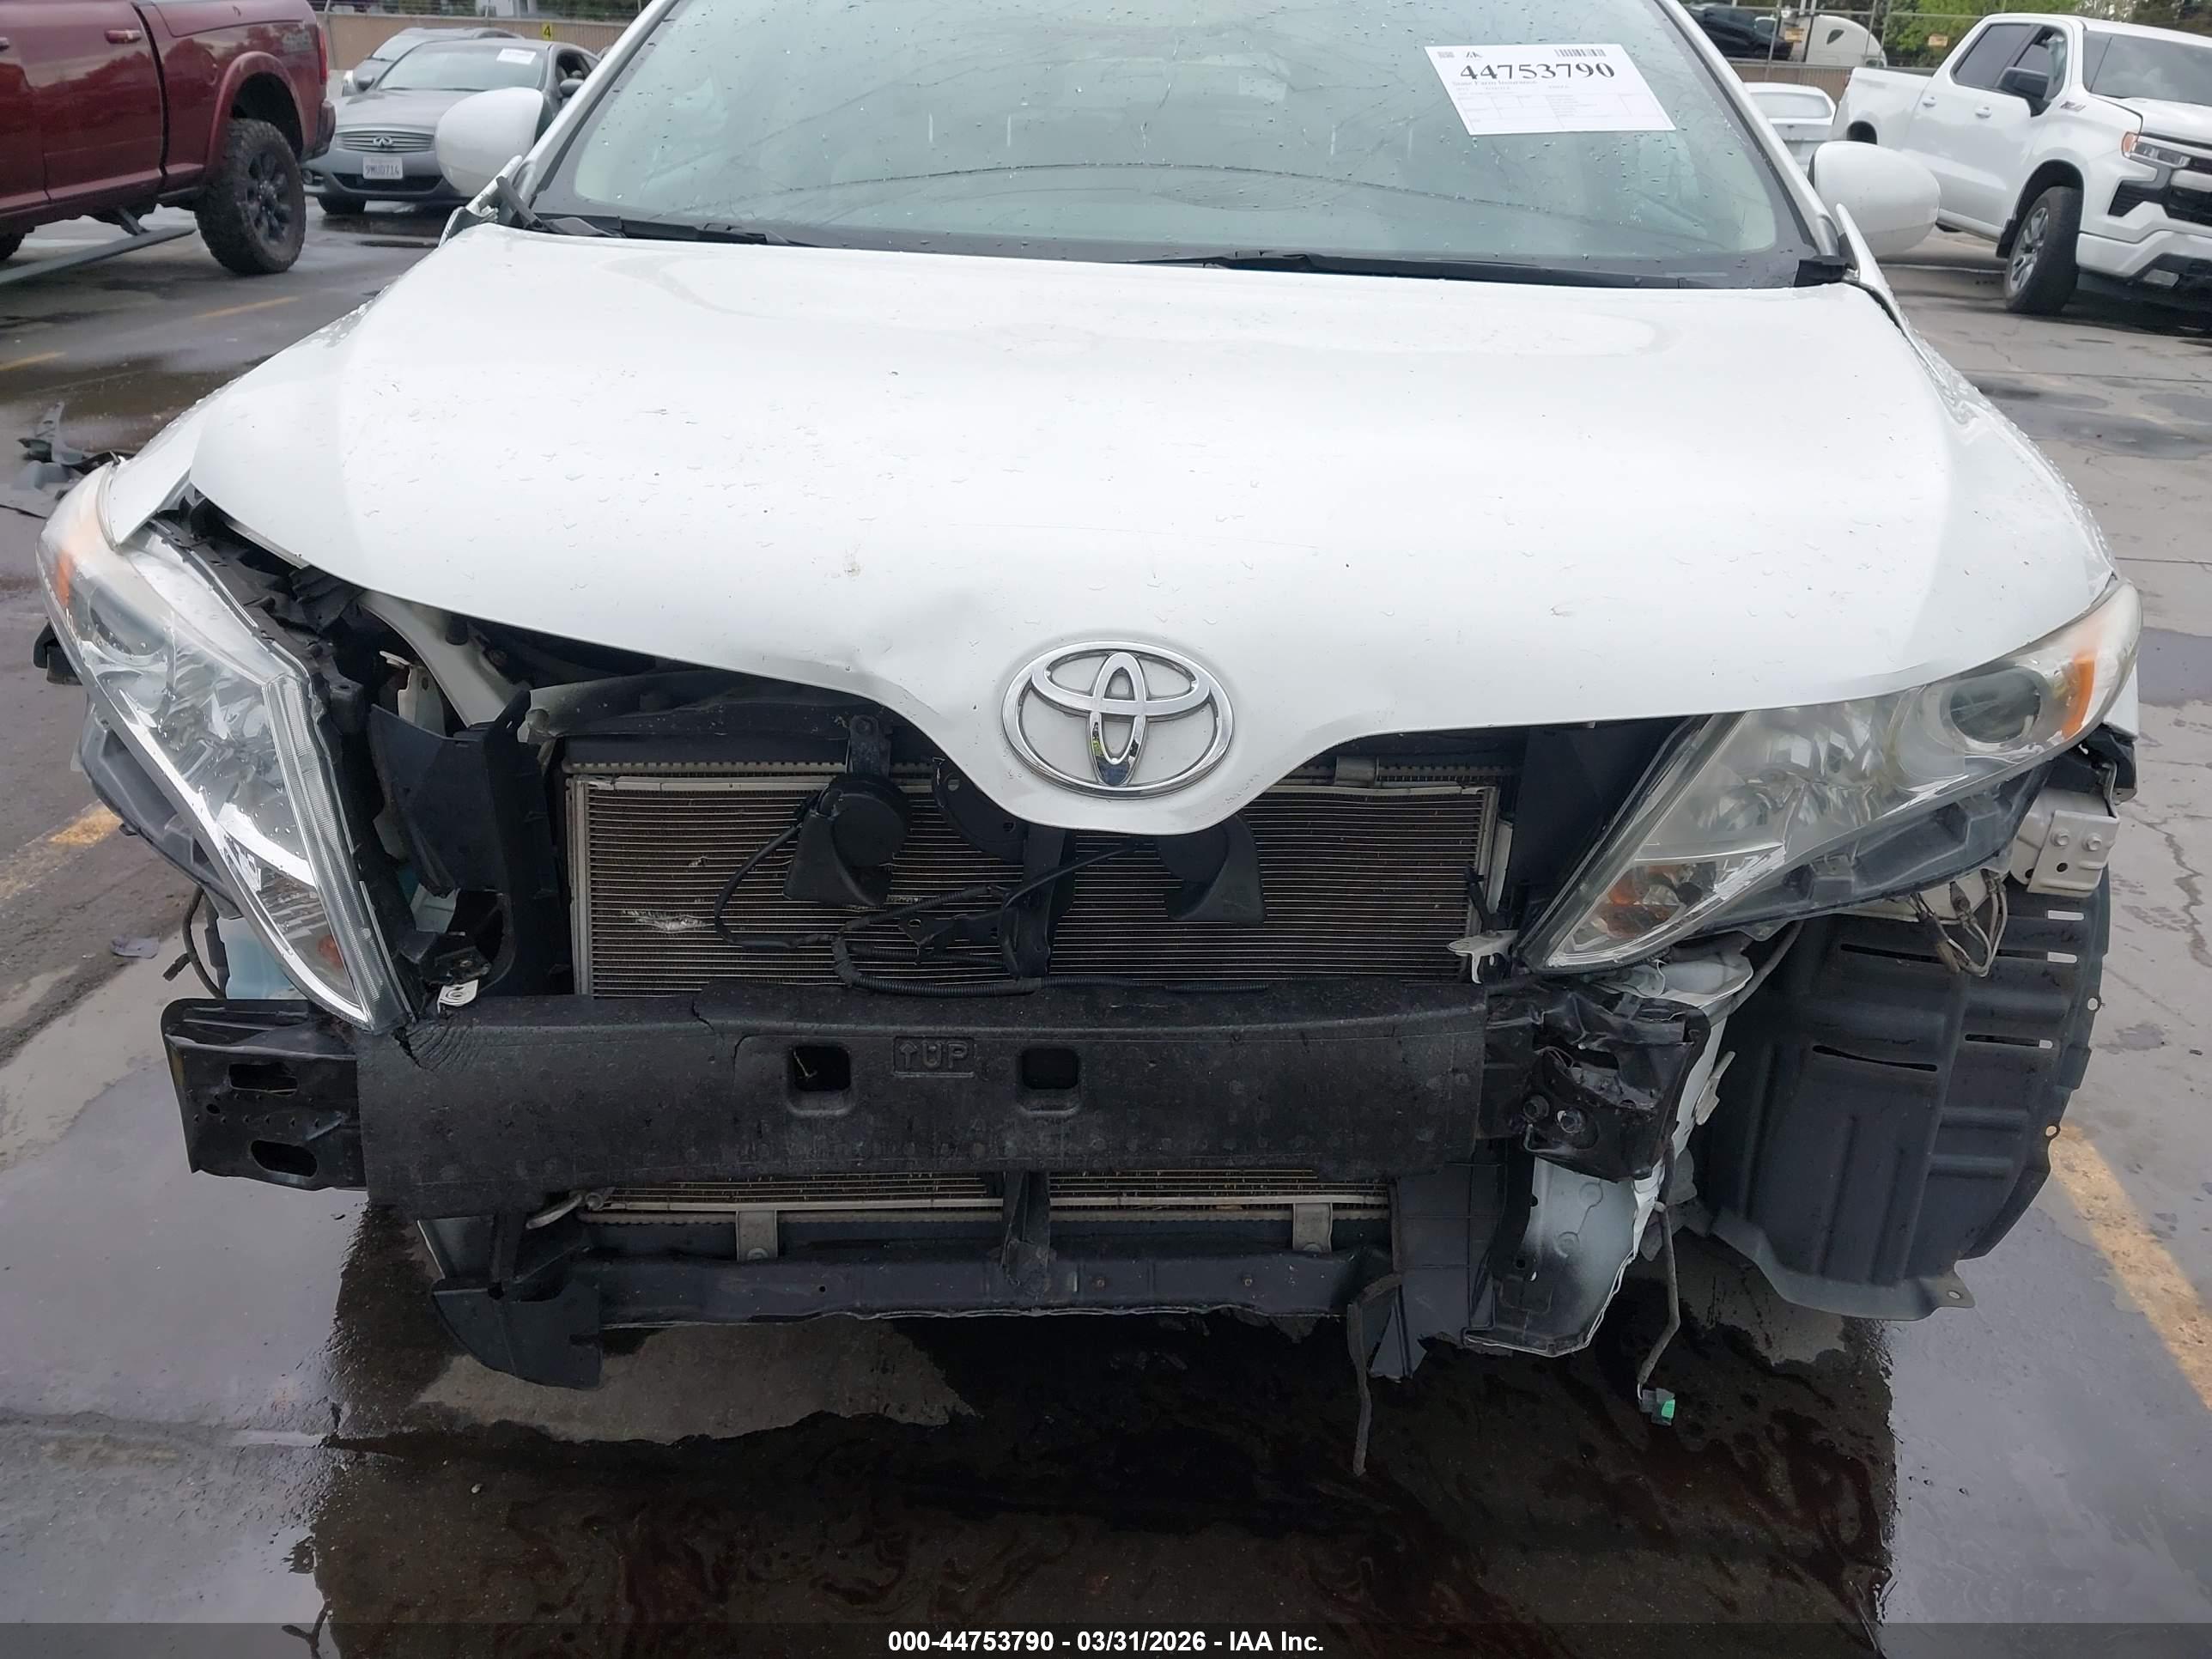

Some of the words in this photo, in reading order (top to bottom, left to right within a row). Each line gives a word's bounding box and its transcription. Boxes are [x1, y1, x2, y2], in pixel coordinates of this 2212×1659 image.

[543, 24, 552, 39] 4
[1461, 63, 1615, 80] 44753790
[921, 1041, 969, 1070] UP
